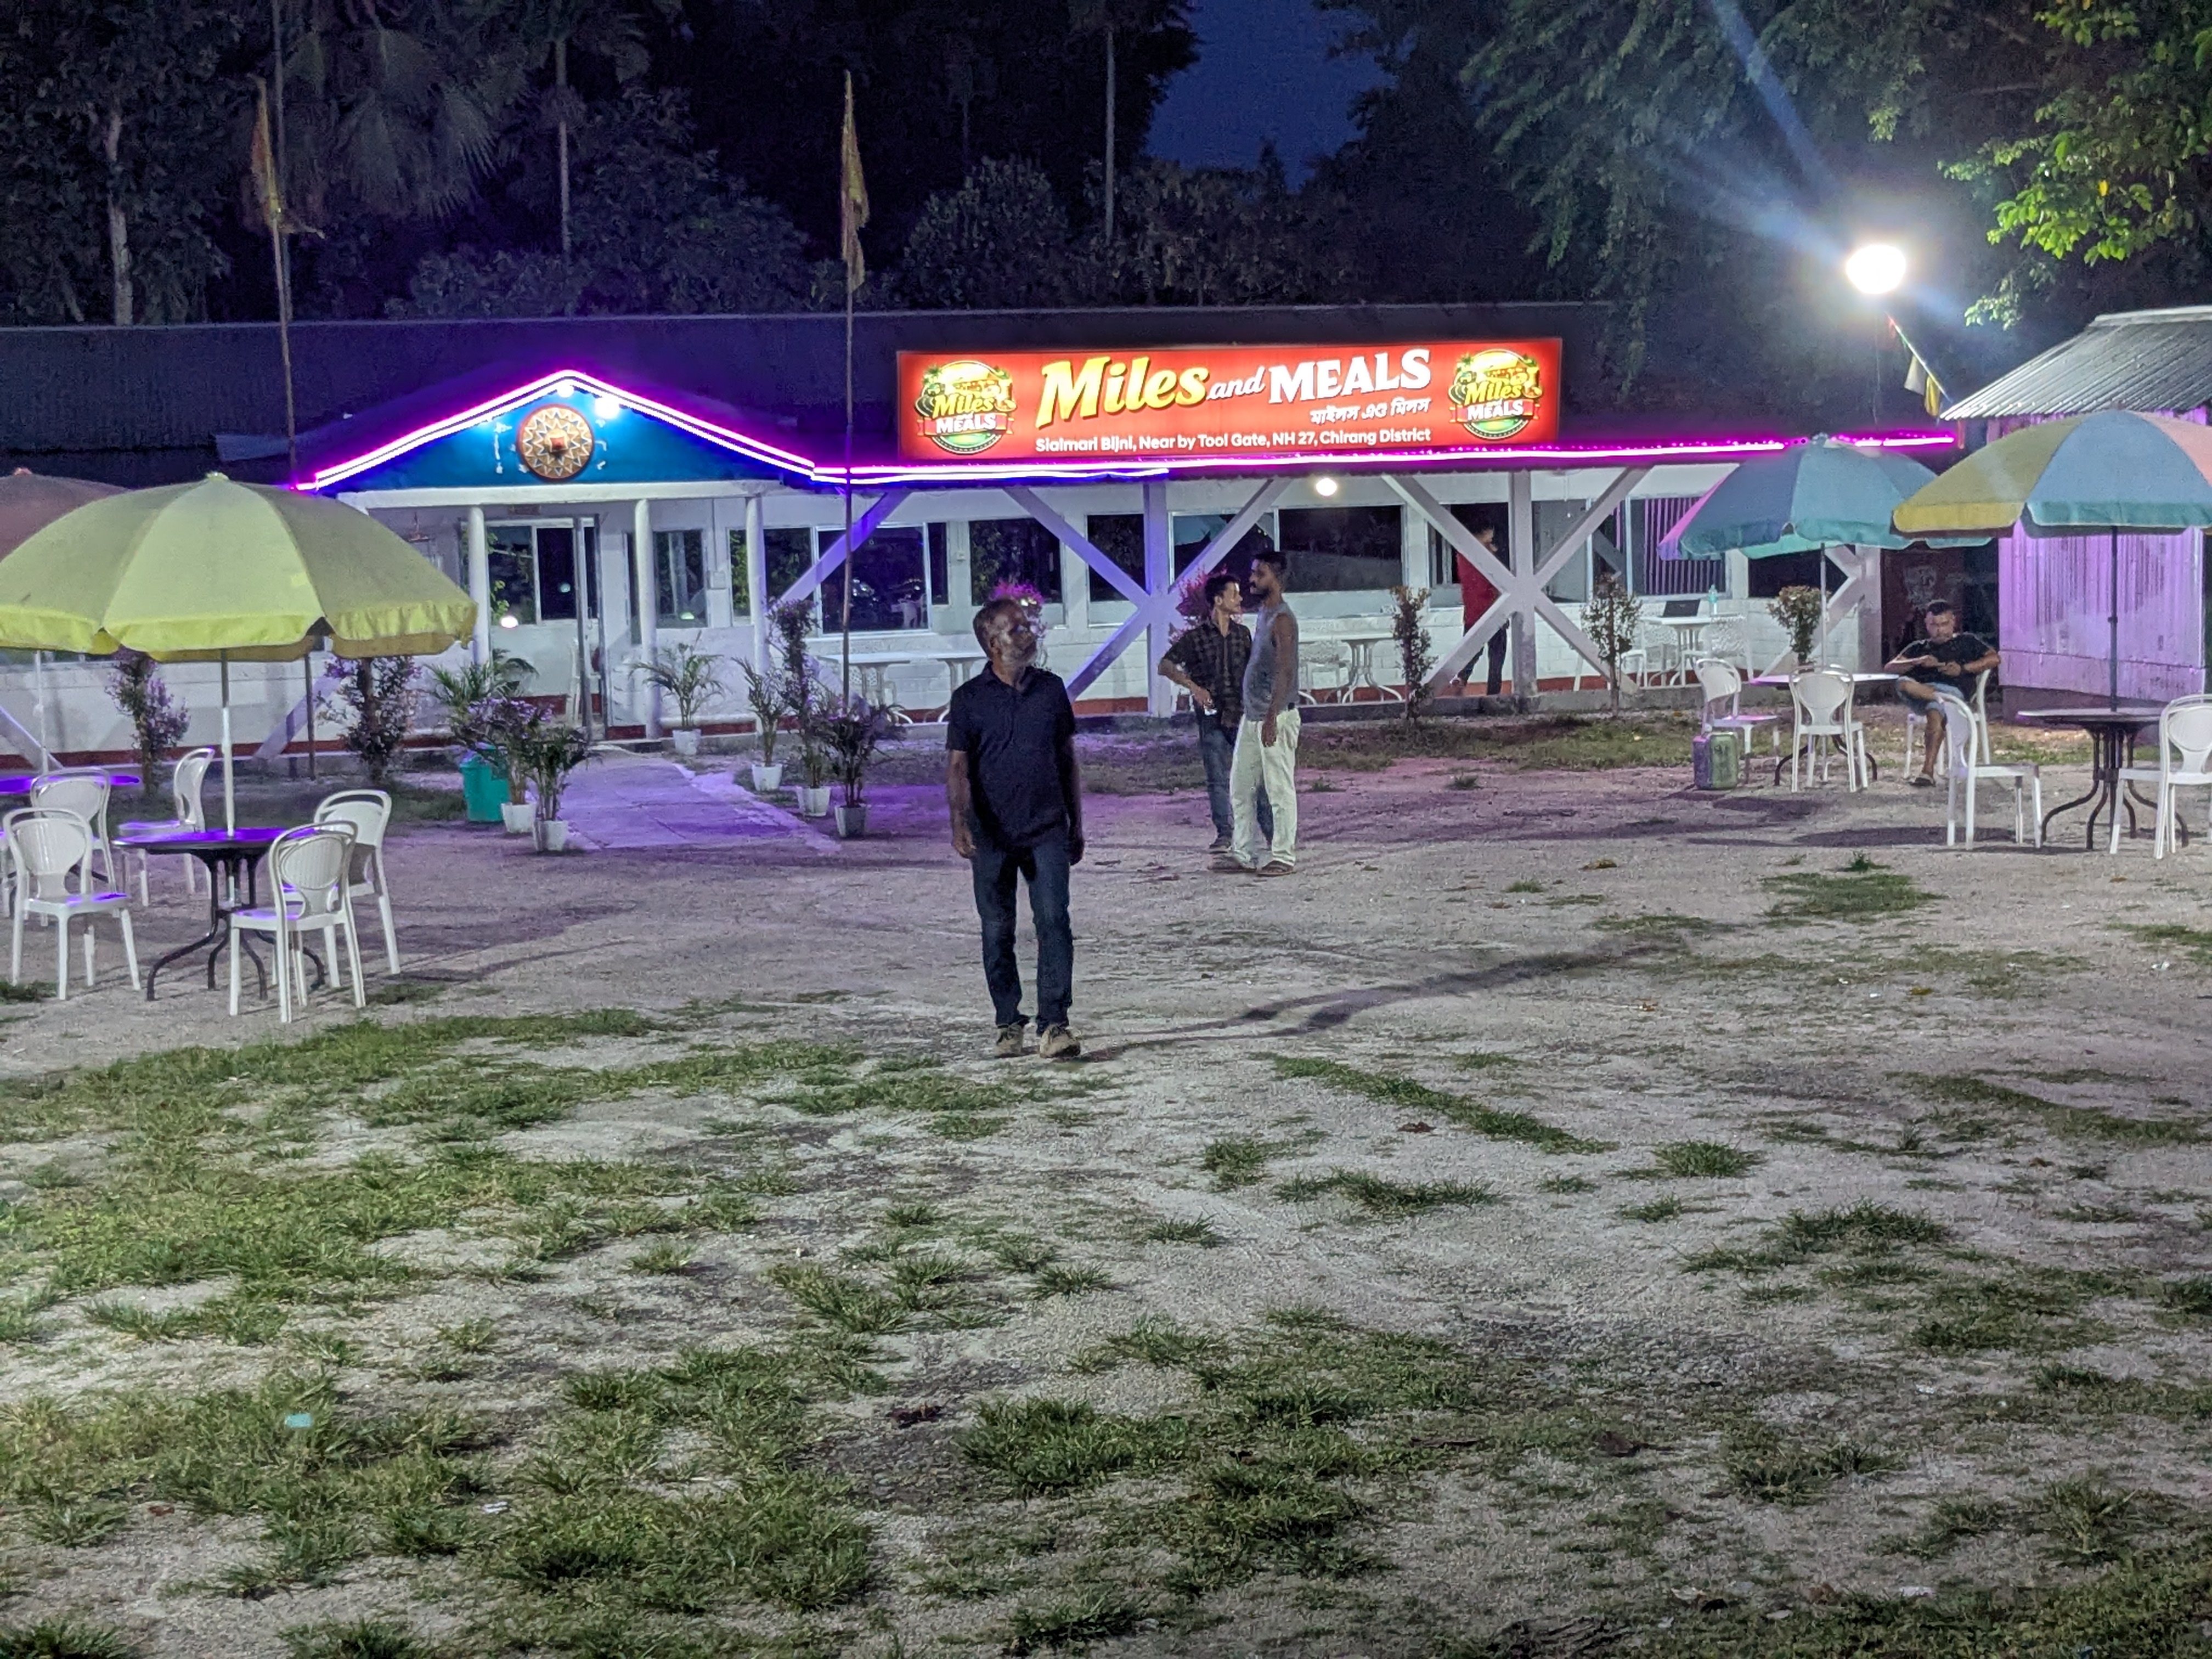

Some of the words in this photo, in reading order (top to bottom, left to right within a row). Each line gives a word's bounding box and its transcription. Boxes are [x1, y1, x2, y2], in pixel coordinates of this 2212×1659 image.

[1036, 356, 1210, 429] Miles
[1205, 365, 1266, 401] and
[1268, 349, 1431, 404] MEALS
[1464, 381, 1522, 406] Miles
[933, 392, 995, 419] Miles
[1467, 399, 1523, 421] MEALS
[936, 413, 996, 433] MEALS
[1139, 436, 1176, 449] Near
[1177, 434, 1195, 450] by
[1198, 433, 1228, 447] Tool
[1231, 432, 1270, 448] Gate,
[1273, 432, 1295, 445] NH
[1298, 431, 1318, 447] 27,
[1319, 429, 1377, 445] Chirang
[1379, 427, 1431, 443] District
